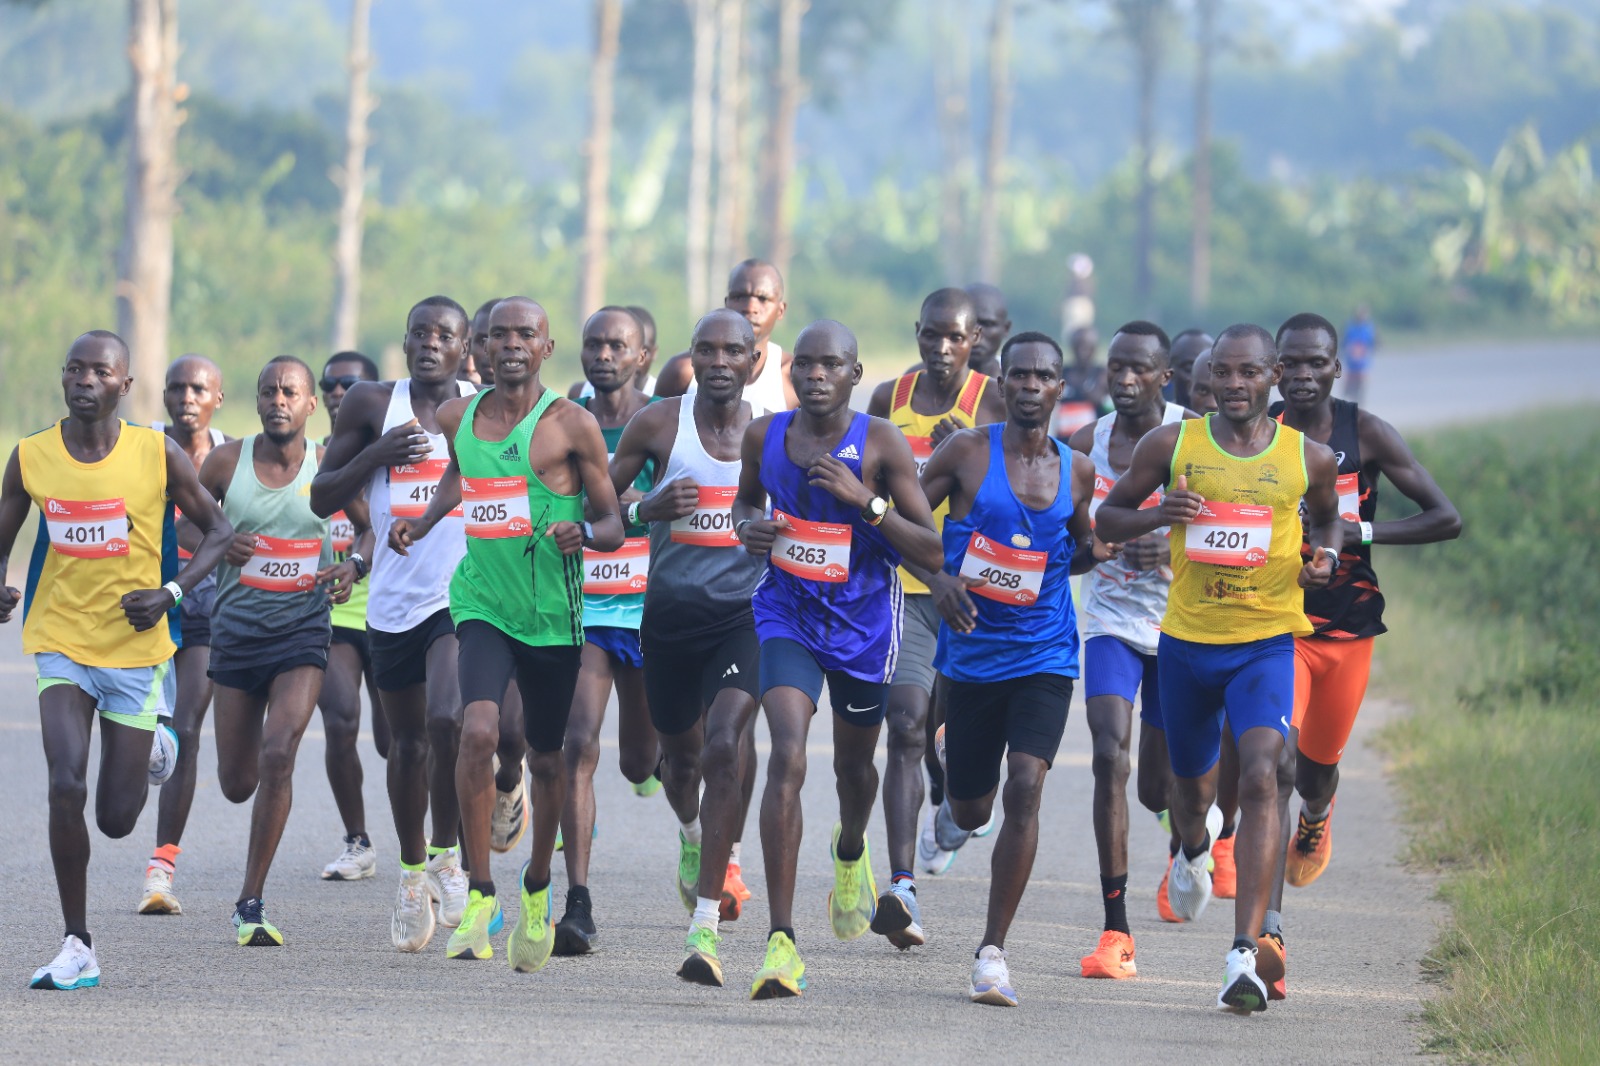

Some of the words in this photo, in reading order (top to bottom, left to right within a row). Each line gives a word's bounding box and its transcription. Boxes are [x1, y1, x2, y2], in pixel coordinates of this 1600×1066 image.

[837, 450, 860, 461] adidas
[471, 503, 507, 522] 4205
[689, 512, 731, 530] 4001
[64, 525, 105, 543] 4011
[1204, 530, 1249, 549] 4201
[786, 543, 827, 565] 4263
[259, 561, 300, 578] 4203
[590, 562, 630, 580] 4014
[978, 566, 1022, 589] 4058
